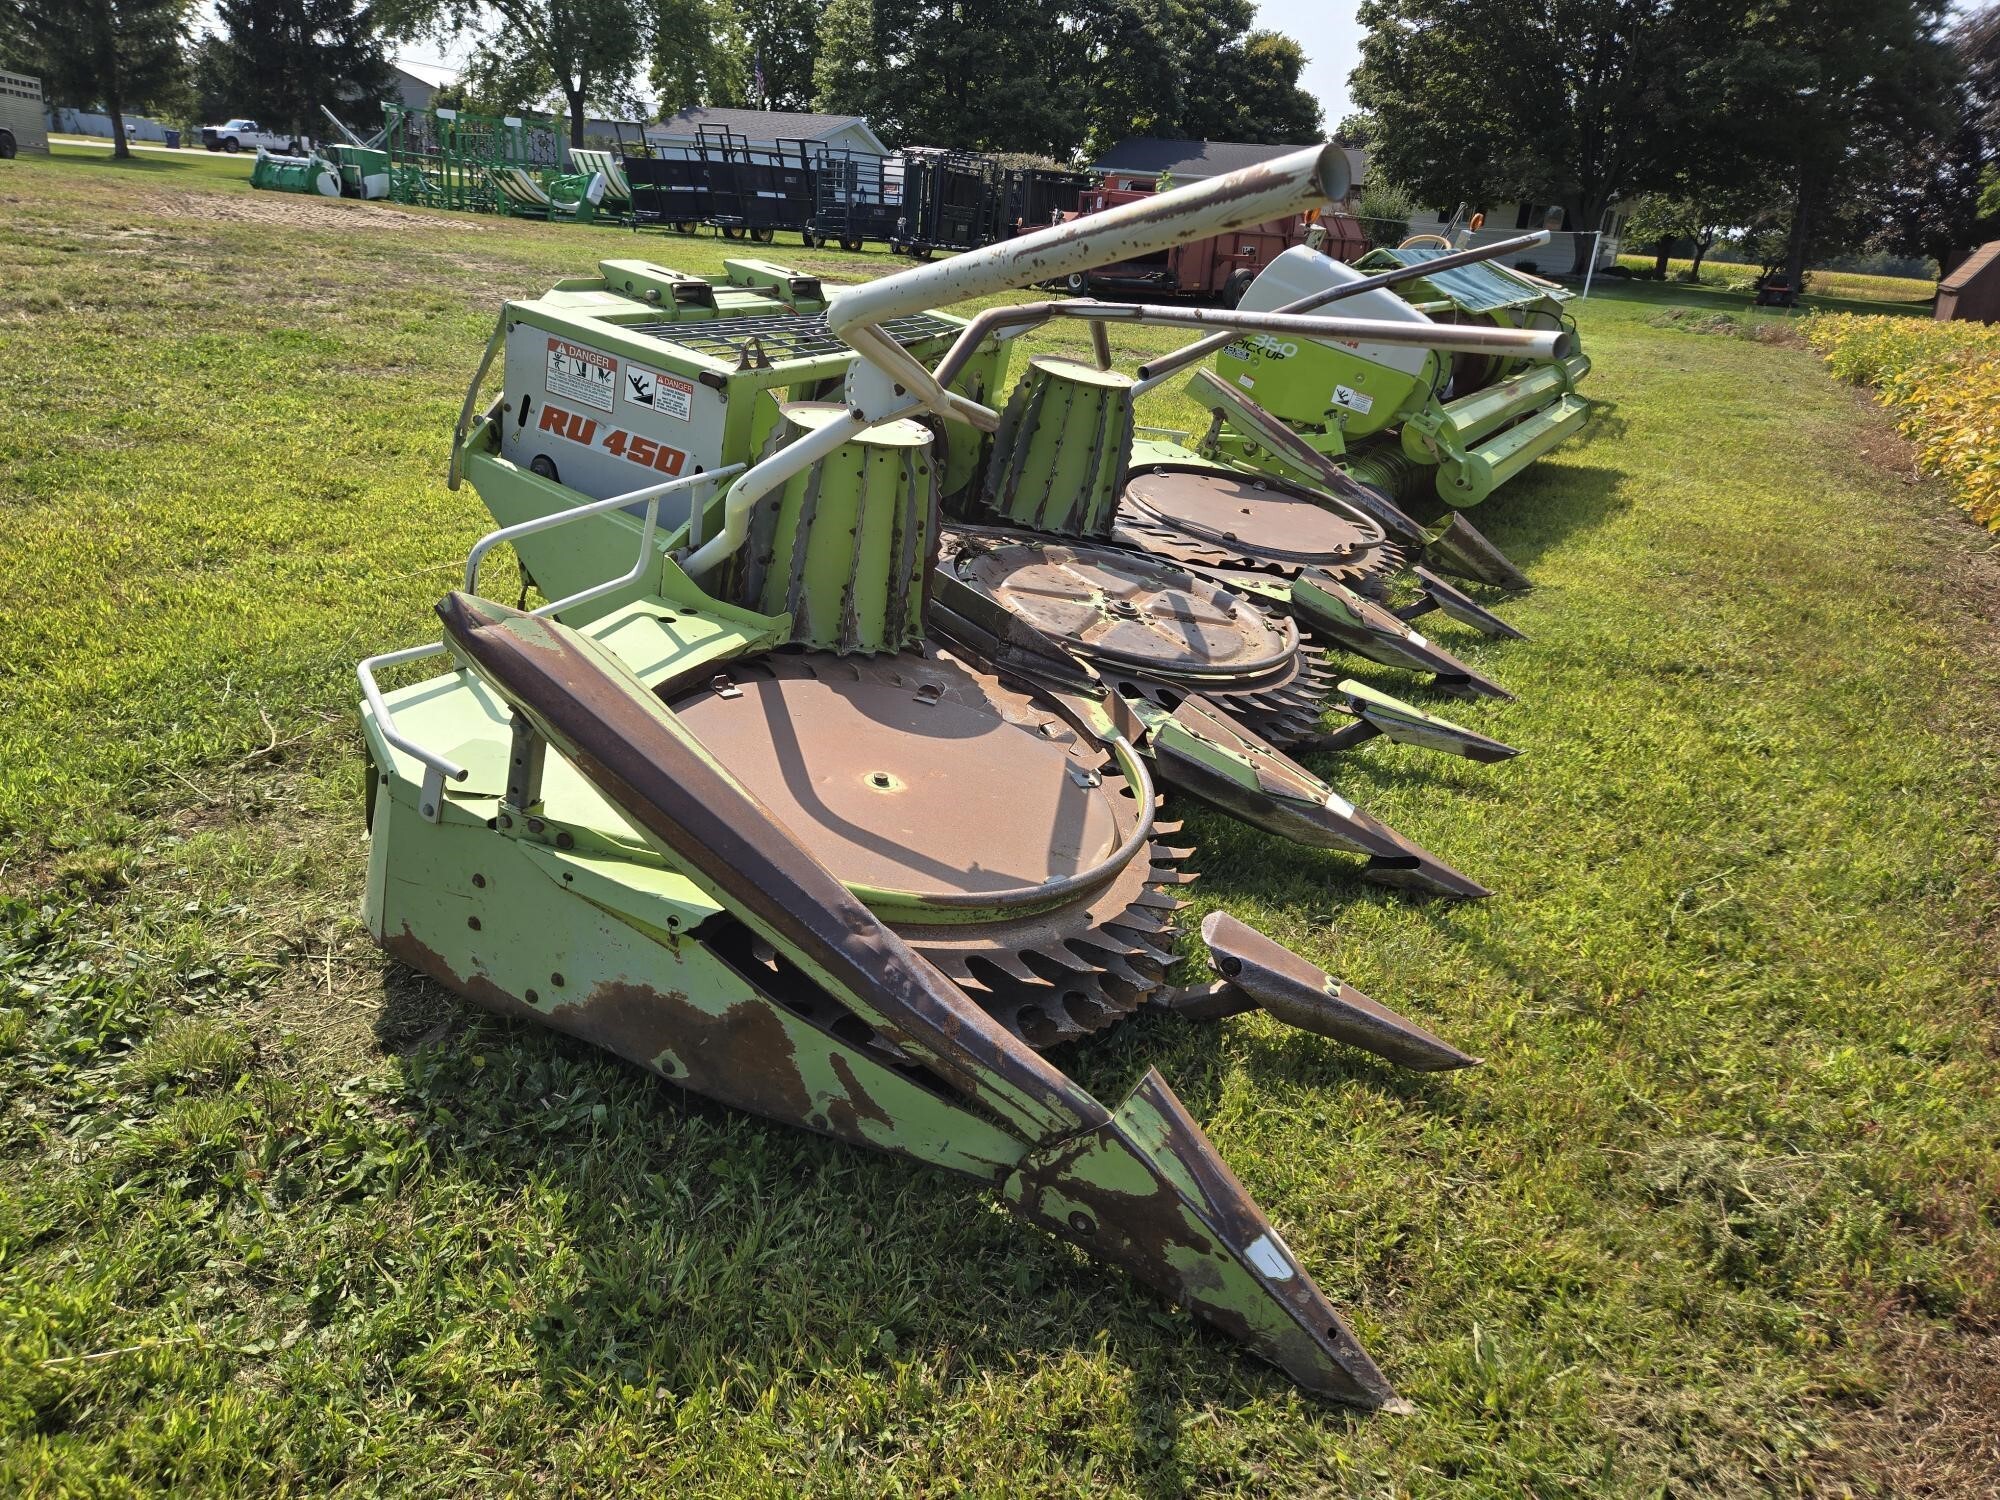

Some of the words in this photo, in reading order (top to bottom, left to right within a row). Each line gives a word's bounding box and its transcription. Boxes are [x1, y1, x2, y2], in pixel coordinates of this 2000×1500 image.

[569, 346, 609, 368] DANGER
[1233, 338, 1265, 355] PICK
[1265, 350, 1286, 360] UP
[664, 378, 692, 393] DANGER
[539, 405, 598, 446] RU
[602, 429, 686, 477] 450
